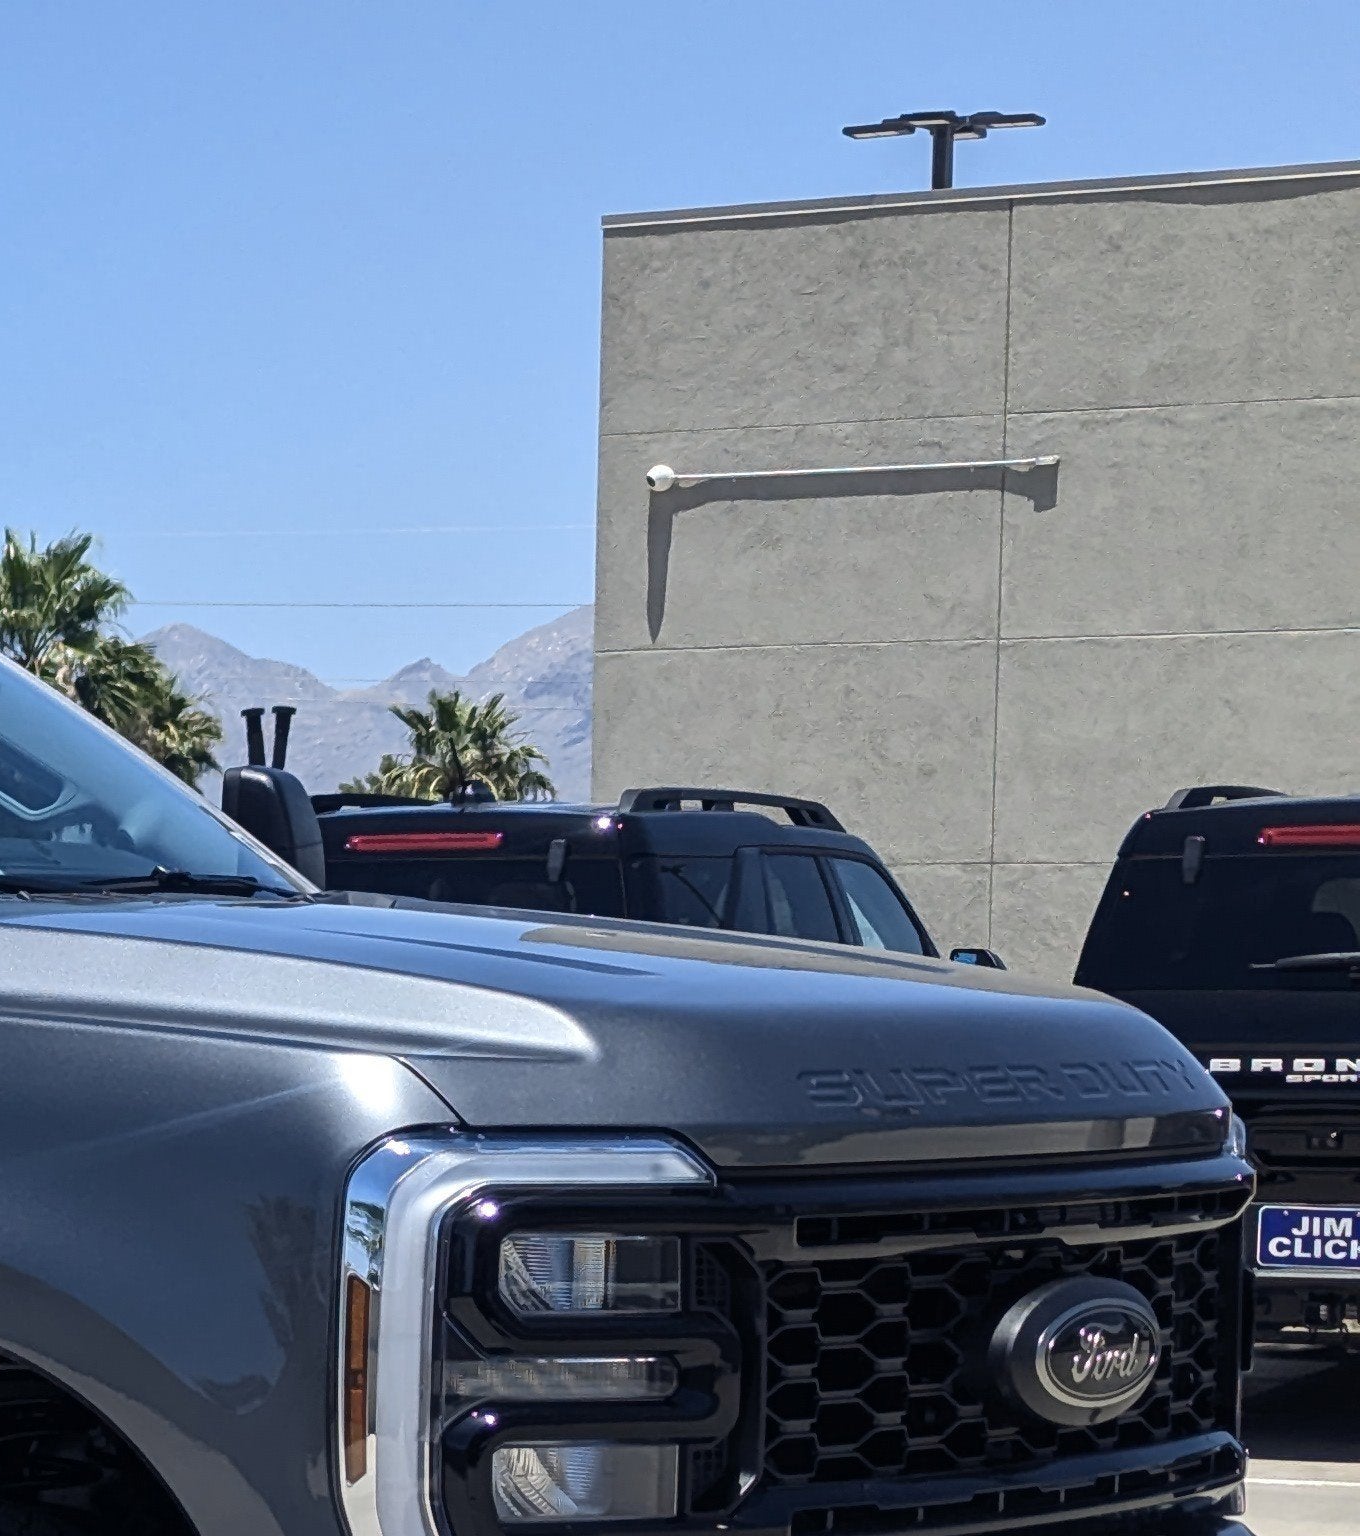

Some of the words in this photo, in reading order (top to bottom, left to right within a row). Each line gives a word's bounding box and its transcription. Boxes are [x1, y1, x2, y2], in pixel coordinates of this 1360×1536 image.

[797, 1064, 1066, 1107] SUPER
[1059, 1059, 1197, 1100] DUTY
[1285, 1074, 1360, 1083] SPOR
[1291, 1216, 1353, 1238] JIM
[1071, 1321, 1147, 1384] Ford
